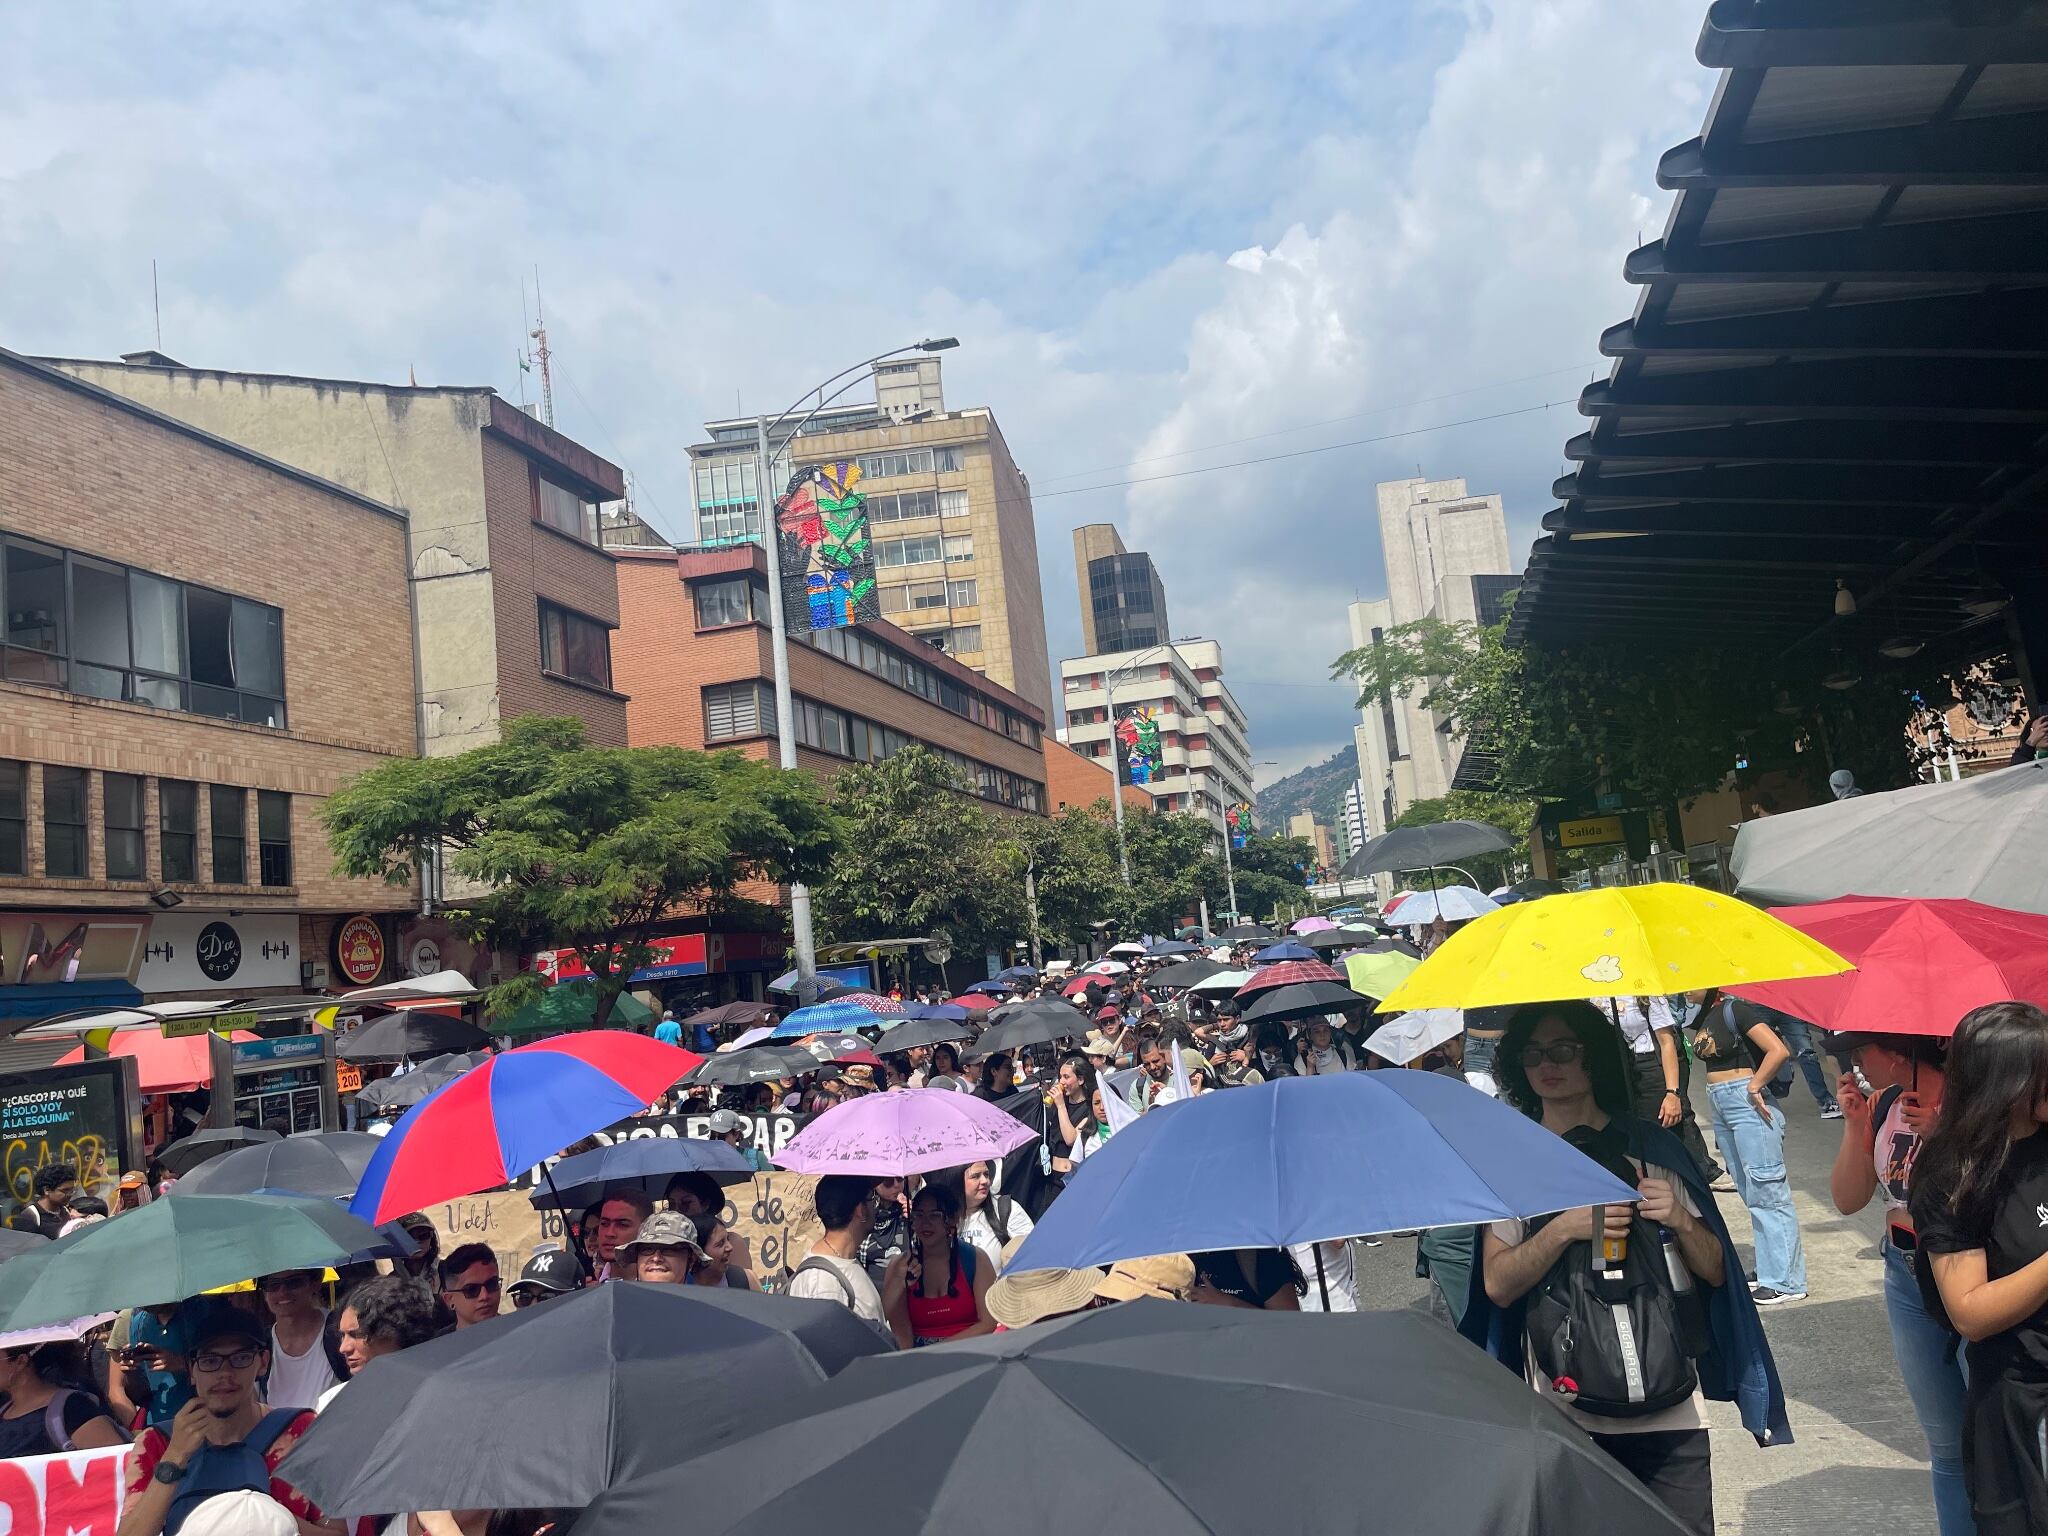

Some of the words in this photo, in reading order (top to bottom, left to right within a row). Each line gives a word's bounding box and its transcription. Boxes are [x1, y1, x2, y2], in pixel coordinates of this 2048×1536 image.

[1567, 827, 1602, 838] Salida
[343, 922, 379, 942] EMPANADAS
[208, 949, 240, 973] STORE
[352, 964, 360, 974] La
[360, 963, 376, 972] Reina
[646, 971, 664, 979] Desde
[342, 1073, 359, 1088] 200
[67, 1085, 87, 1098] QUÉ
[2, 1108, 11, 1118] SI
[12, 1104, 38, 1116] SOLO
[40, 1101, 62, 1113] VOY
[2, 1119, 10, 1129] A
[11, 1117, 24, 1128] LA
[751, 1177, 785, 1226] de
[760, 1226, 789, 1269] el
[532, 1254, 554, 1272] NY
[1619, 1321, 1640, 1386] GIGABAGS
